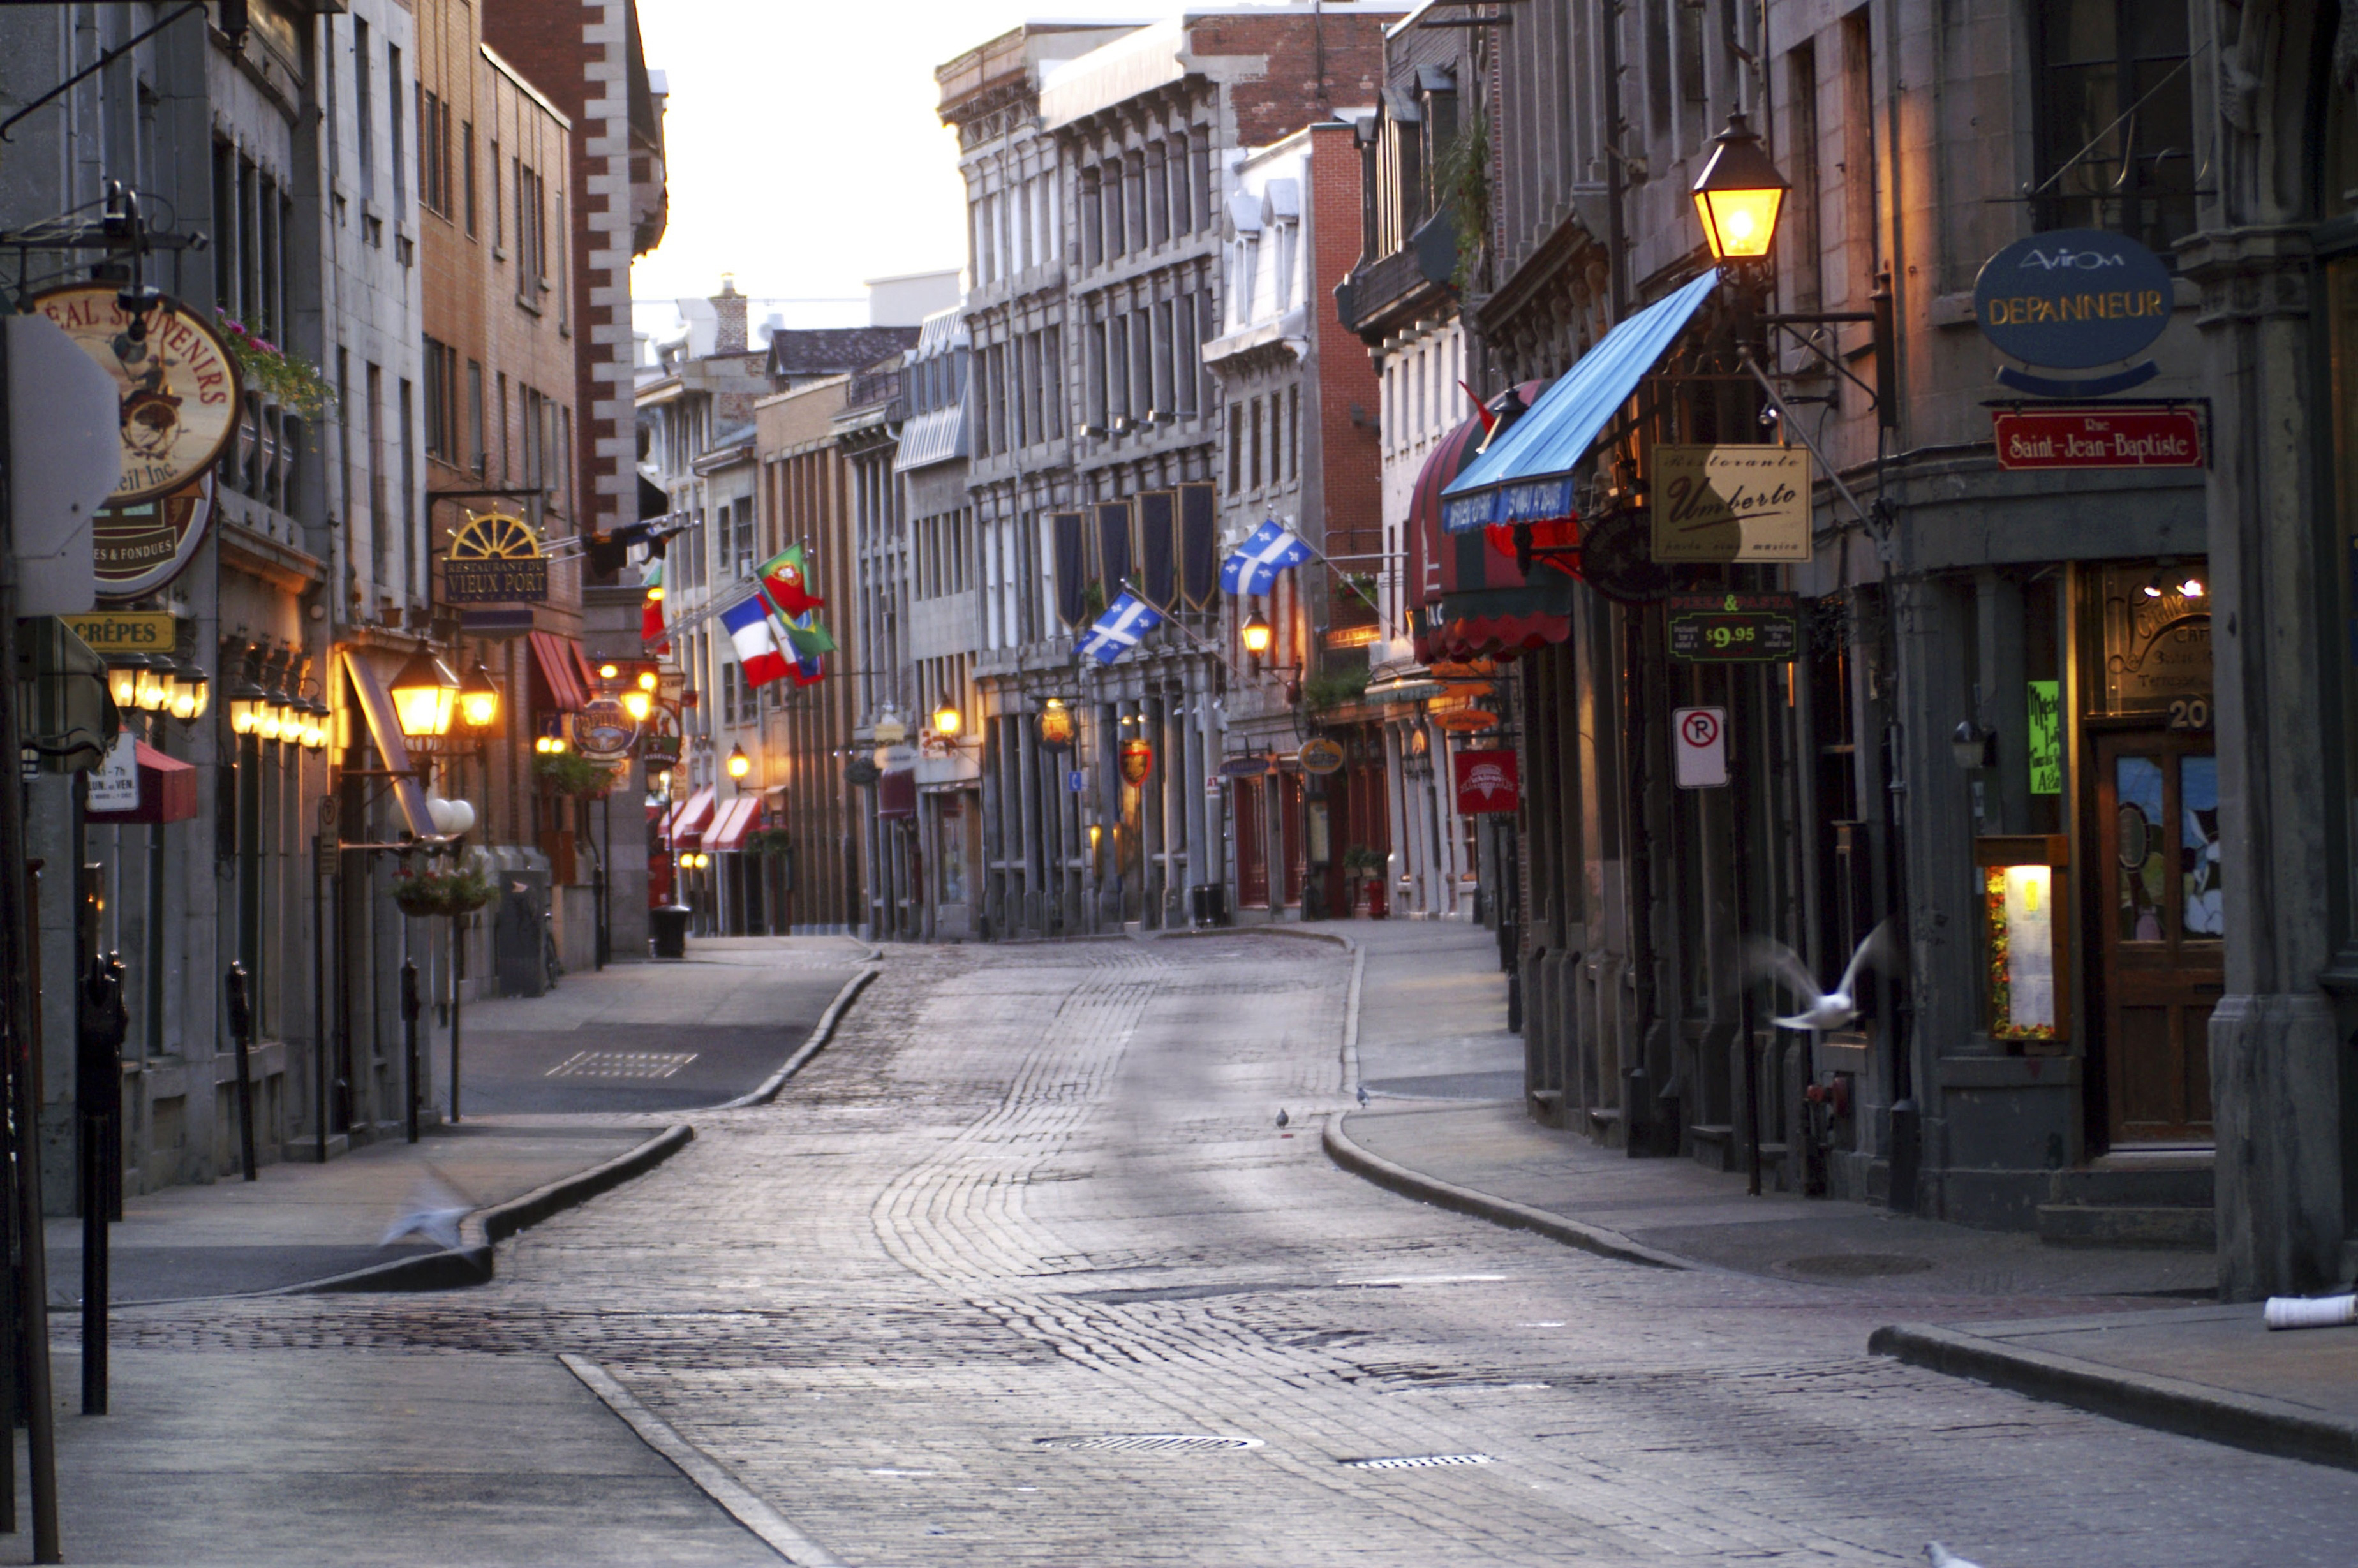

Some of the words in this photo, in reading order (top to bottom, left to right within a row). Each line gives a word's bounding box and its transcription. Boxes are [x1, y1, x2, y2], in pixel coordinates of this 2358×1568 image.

[1989, 290, 2163, 325] DEPANNEUR
[110, 302, 226, 404] SUVENIRS
[2084, 418, 2109, 432] Rue
[1664, 455, 1799, 467] Ristorante
[114, 470, 140, 491] eil
[145, 462, 178, 485] Inc.
[1667, 475, 1797, 523] Umberto
[110, 549, 117, 561] &
[121, 539, 172, 559] FONDUES
[448, 561, 524, 572] RESTAURANT
[528, 562, 544, 572] DU
[448, 573, 499, 593] VIEUX
[504, 572, 544, 592] PORT
[1670, 596, 1726, 609] PIZZA
[1724, 593, 1739, 612] &
[1735, 596, 1794, 609] PASTA
[74, 618, 156, 643] CRÊPES
[1705, 626, 1756, 648] $9.95
[2174, 627, 2211, 644] CAF
[2169, 699, 2208, 729] 20
[644, 753, 677, 764] ASSEURS
